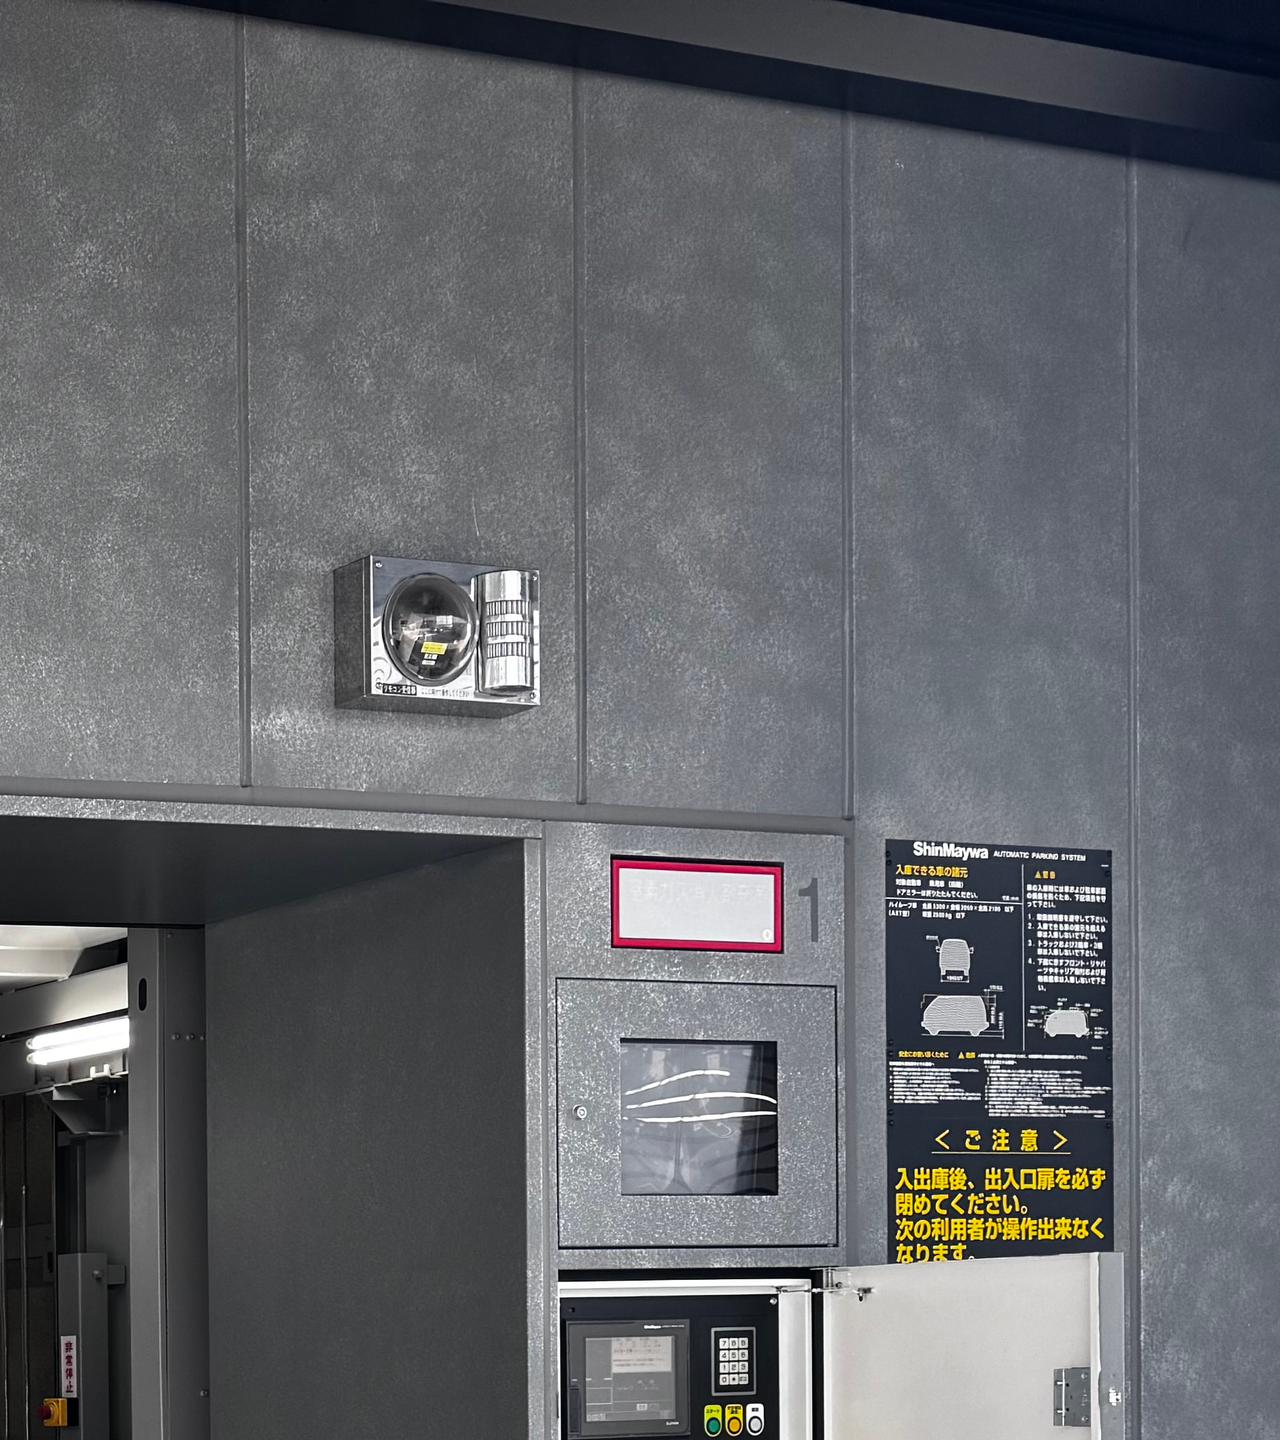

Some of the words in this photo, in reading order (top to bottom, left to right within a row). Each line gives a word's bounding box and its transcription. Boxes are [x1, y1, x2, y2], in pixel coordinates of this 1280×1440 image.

[913, 841, 989, 861] ShinMaywa
[993, 851, 1029, 859] AUTOMATIC
[1032, 852, 1058, 860] PARKING
[1061, 853, 1086, 862] SYSTEM
[895, 1167, 1106, 1191] 入出庫後、出入口扉を必ず
[895, 1193, 1027, 1216] 閉めてください。
[895, 1217, 1104, 1241] 次の利用者が操作出来なく
